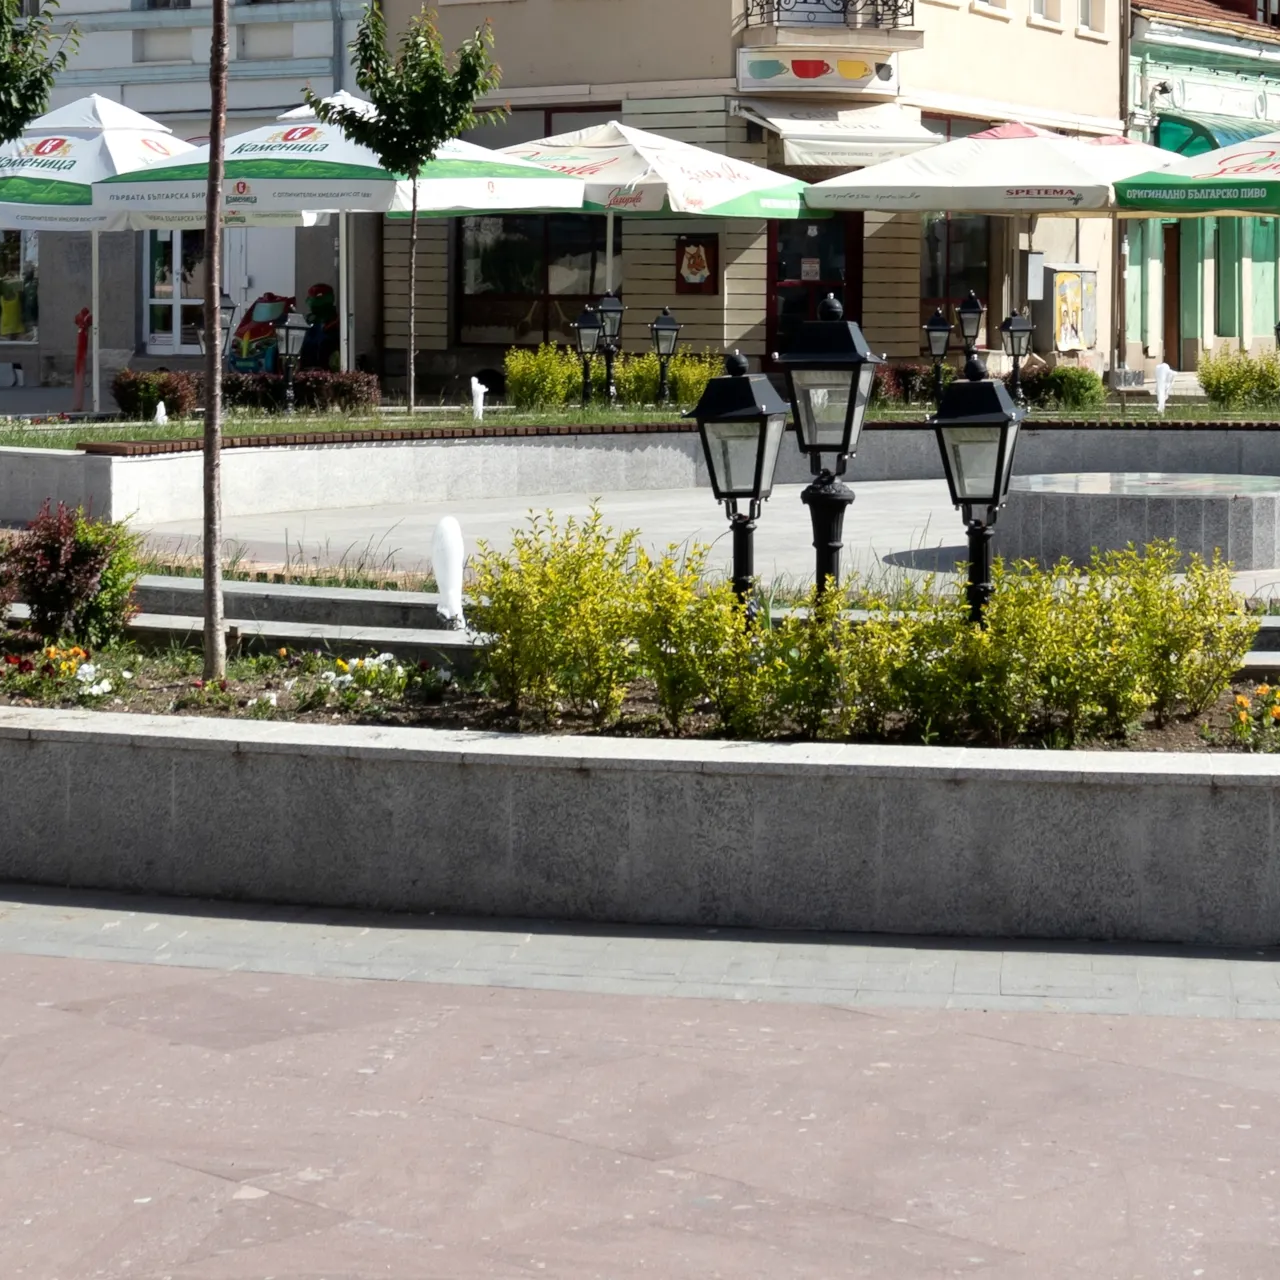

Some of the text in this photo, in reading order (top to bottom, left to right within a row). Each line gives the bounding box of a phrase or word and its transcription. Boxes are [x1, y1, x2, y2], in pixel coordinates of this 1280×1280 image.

[230, 142, 329, 155] Каменица
[147, 192, 189, 201] БЪЛГАРСКА
[1126, 188, 1266, 200] ОРИГИНАЛНО БЪЛГАРСКО ПИВО
